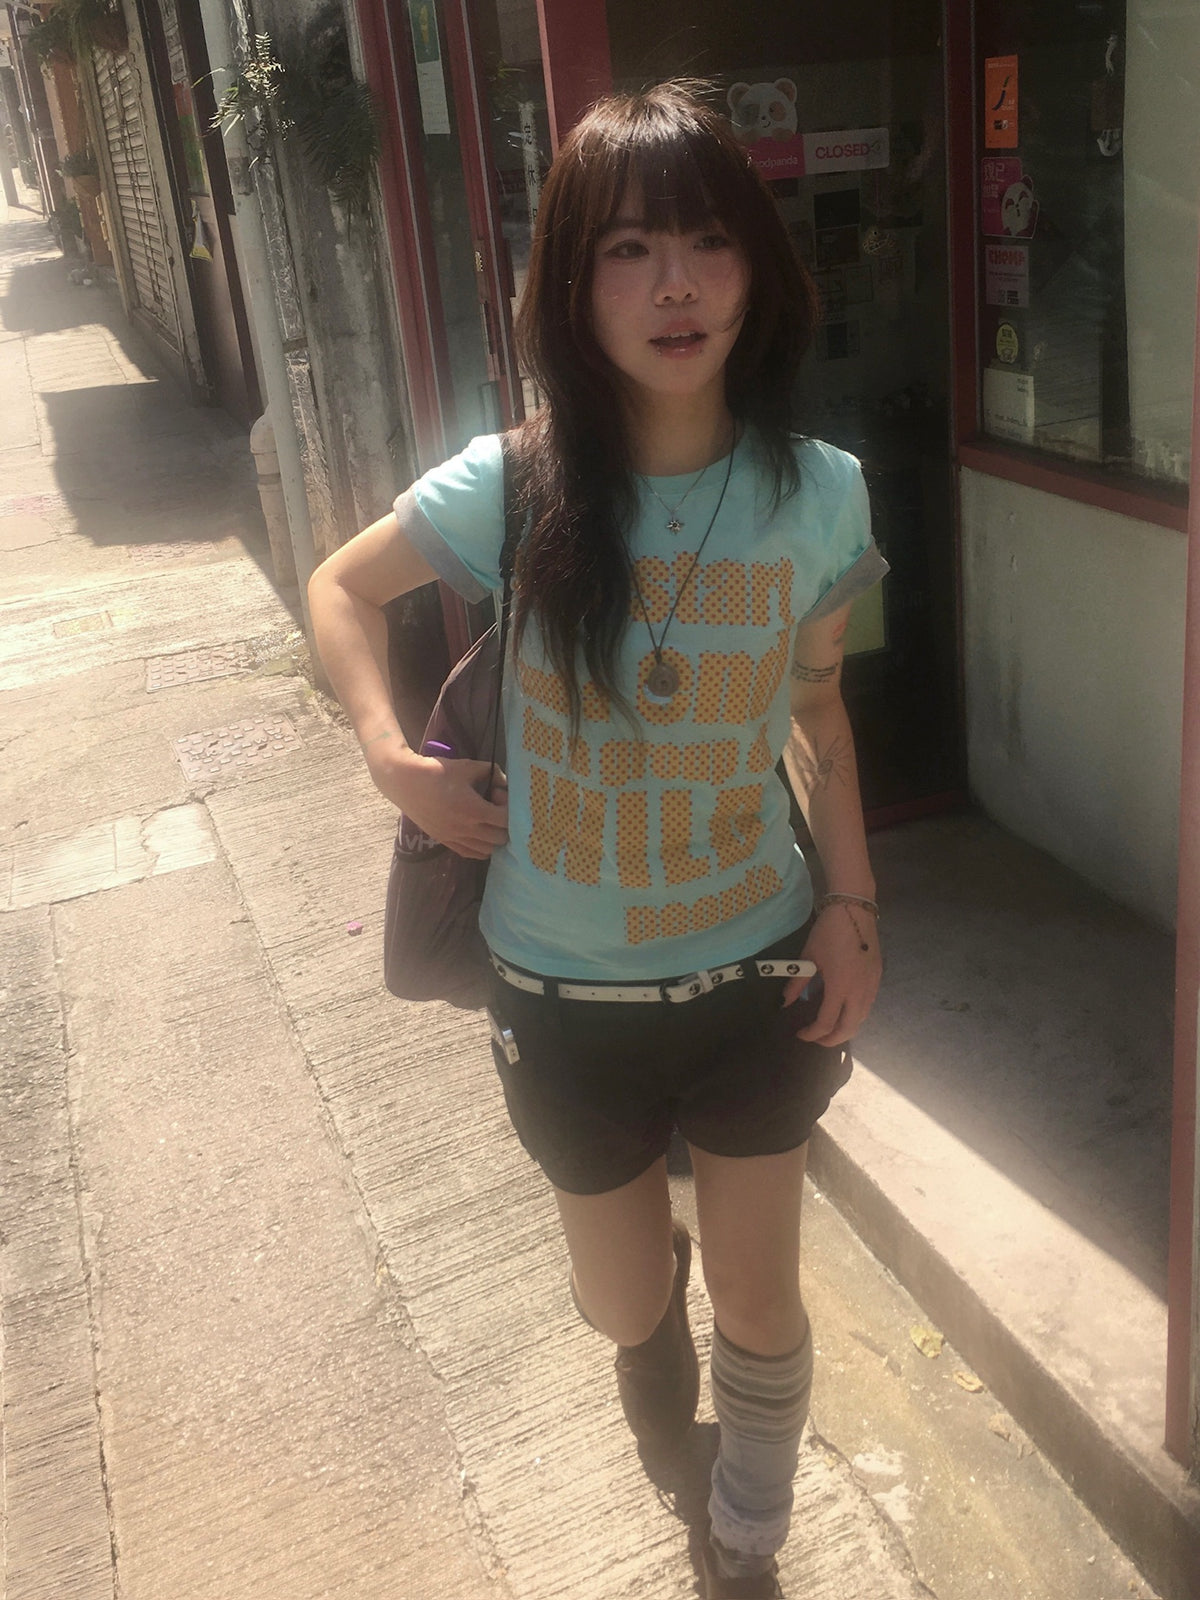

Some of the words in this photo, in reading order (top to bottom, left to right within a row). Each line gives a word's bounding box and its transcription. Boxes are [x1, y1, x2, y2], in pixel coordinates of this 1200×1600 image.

[752, 155, 799, 170] oodpanda
[815, 143, 871, 160] CLOSED
[599, 738, 740, 786] group
[528, 764, 766, 888] WILD
